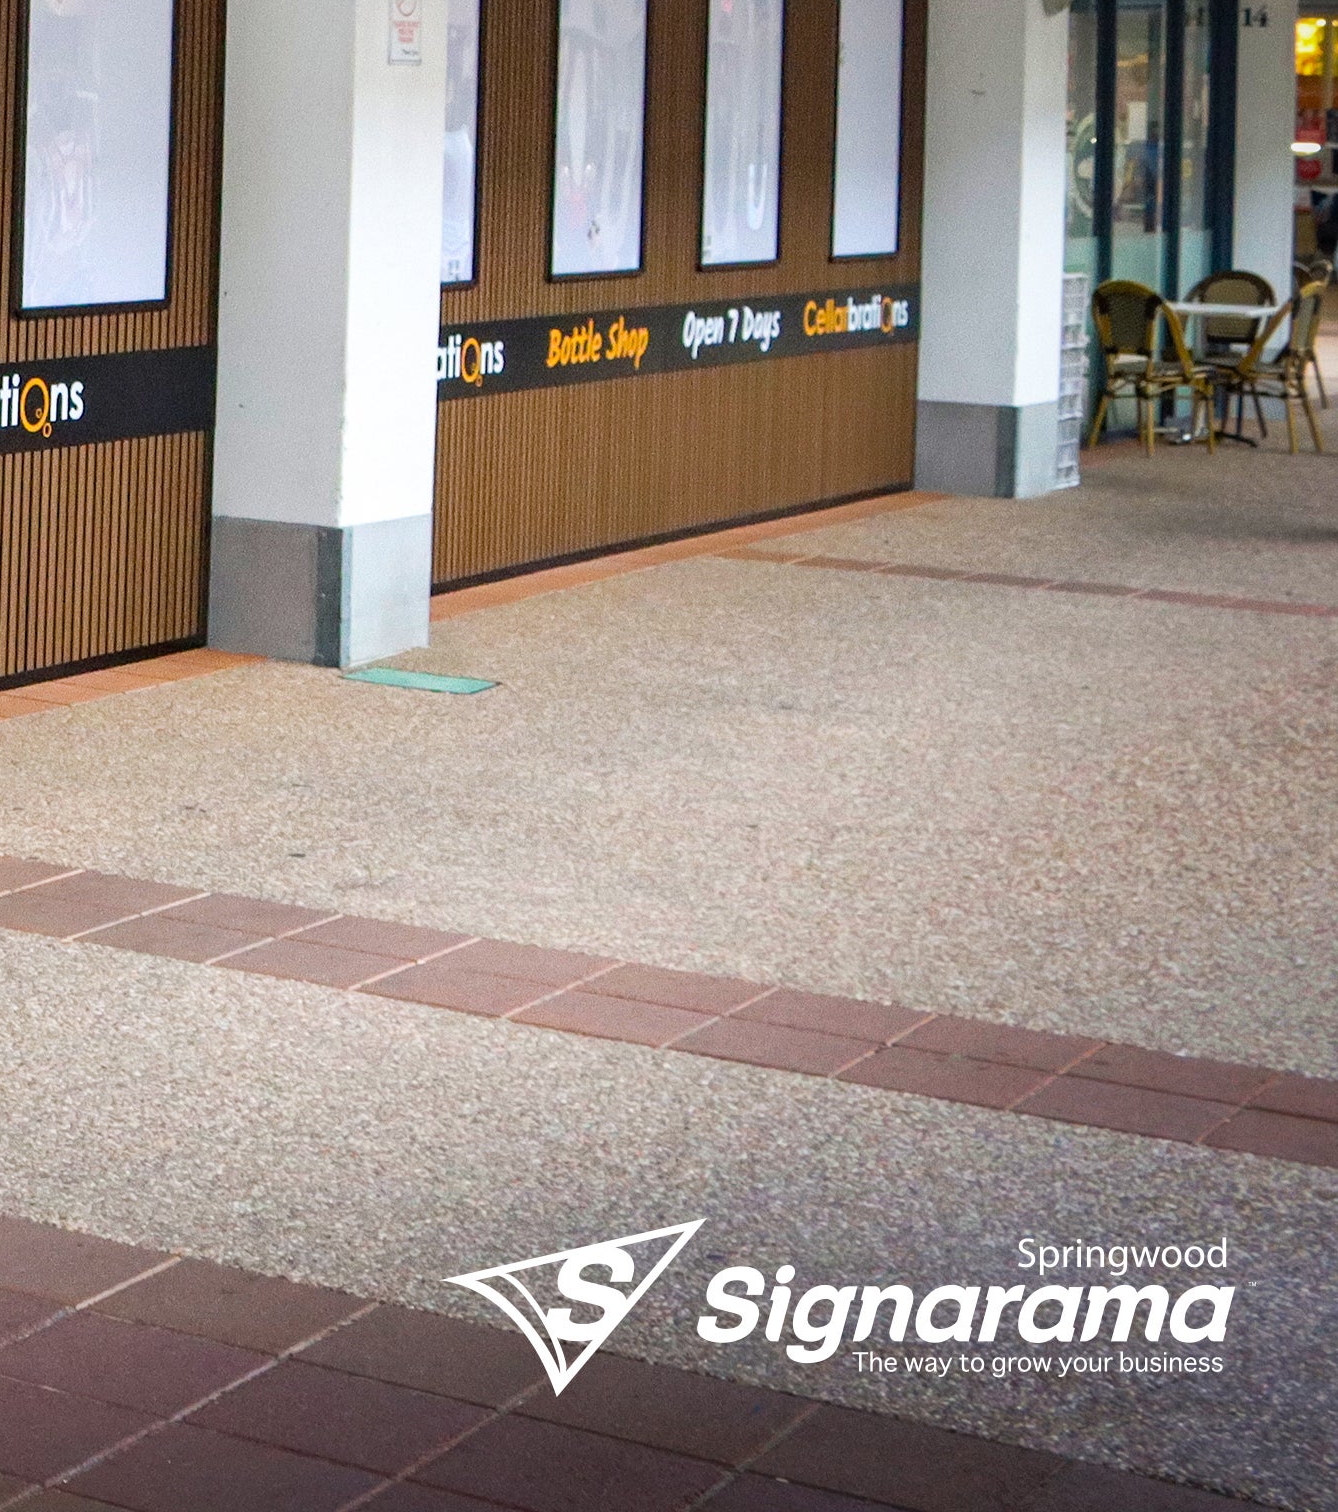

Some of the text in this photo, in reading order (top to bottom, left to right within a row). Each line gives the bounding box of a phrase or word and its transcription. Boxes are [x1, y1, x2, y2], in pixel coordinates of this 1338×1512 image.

[546, 315, 649, 370] Bottle Shop
[683, 306, 781, 360] Open 7 Days
